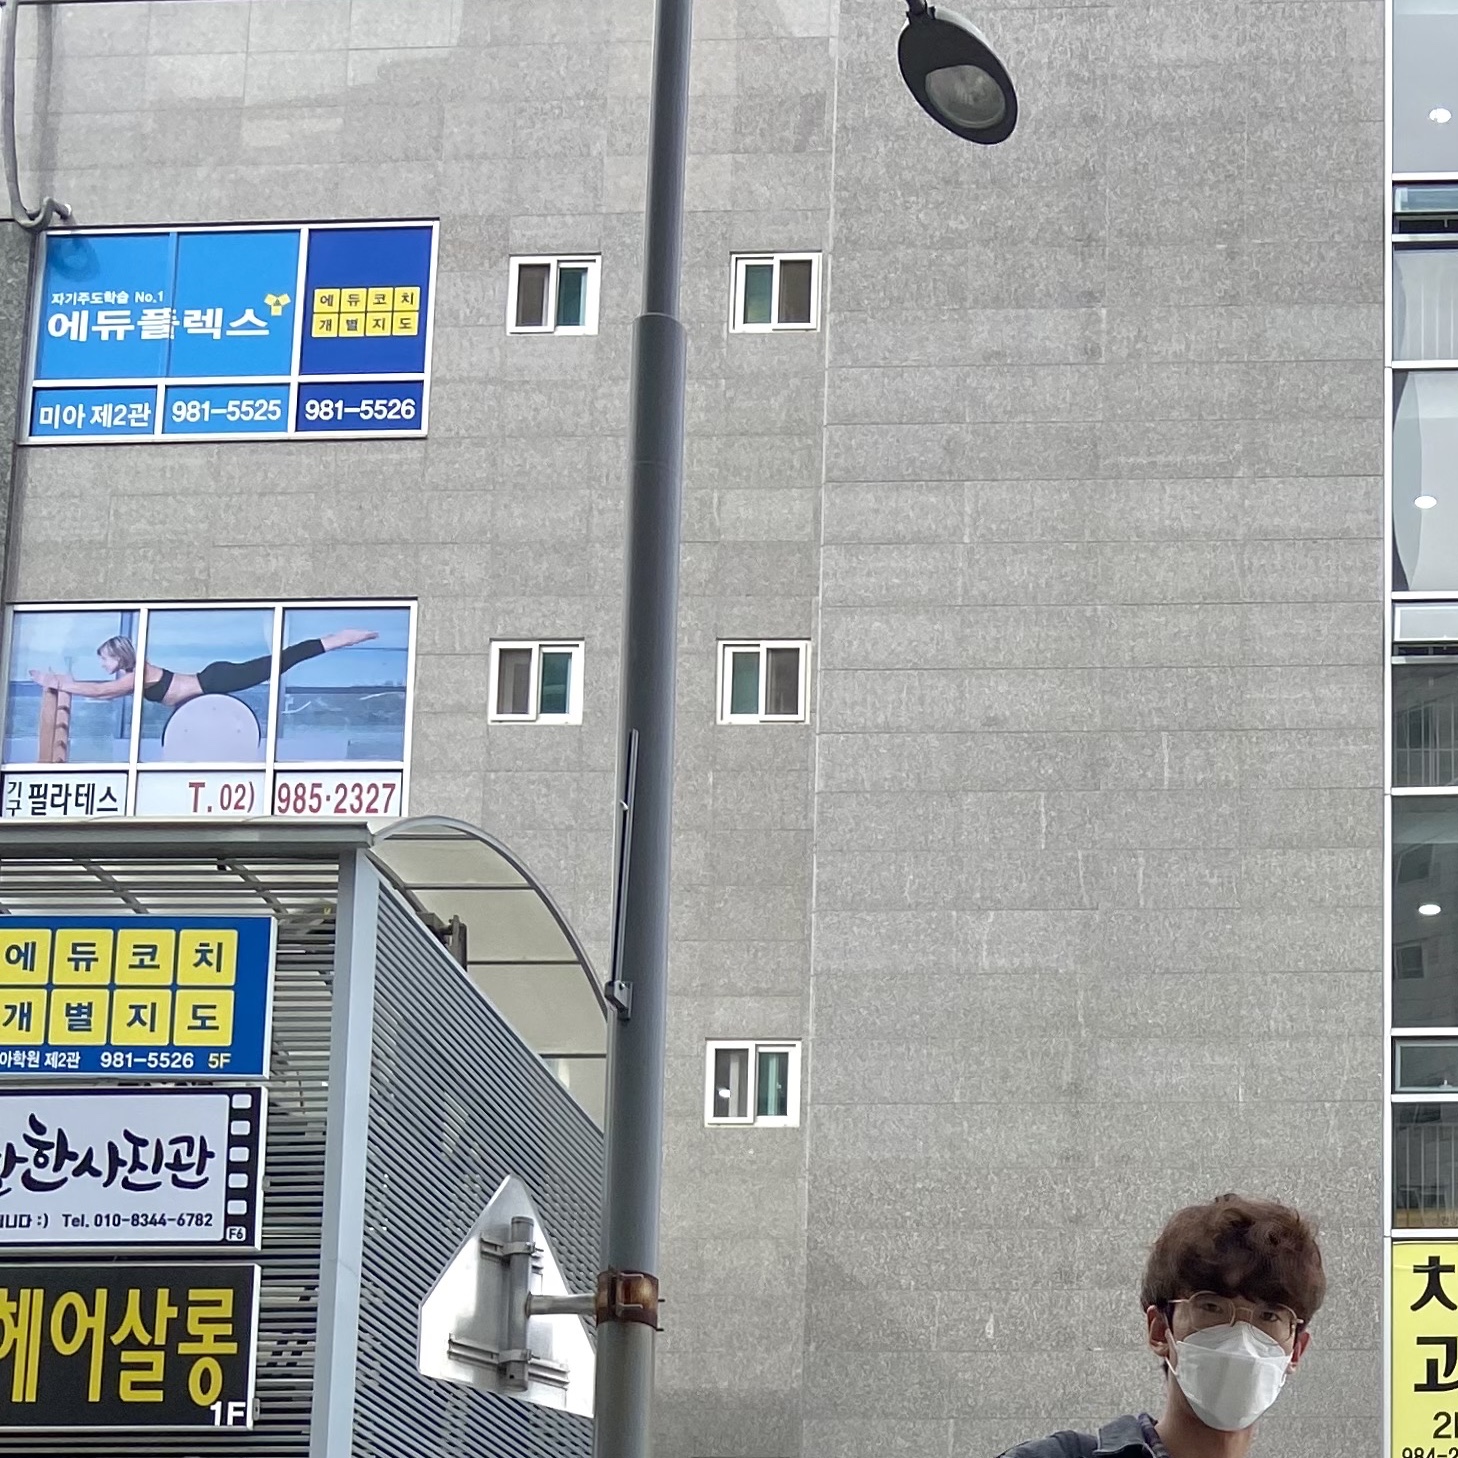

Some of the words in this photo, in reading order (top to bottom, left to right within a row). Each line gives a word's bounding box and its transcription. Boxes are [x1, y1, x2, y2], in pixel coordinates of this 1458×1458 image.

[52, 291, 129, 304] 자기주도학습
[135, 290, 164, 303] No.1
[47, 308, 269, 341] 에듀플렉스
[39, 404, 86, 429] 미아
[90, 402, 151, 428] 제2관
[172, 400, 281, 422] 981-5525
[305, 398, 416, 421] 981-5526
[28, 782, 119, 816] 필라테스
[44, 1052, 80, 1068] 제2관
[100, 1052, 194, 1068] 981-5526
[208, 1052, 231, 1069] 5F
[62, 1213, 90, 1228] Tel.
[94, 1213, 213, 1228] 010-8344-6782
[228, 1228, 243, 1240] F6
[210, 1401, 246, 1426] 1F
